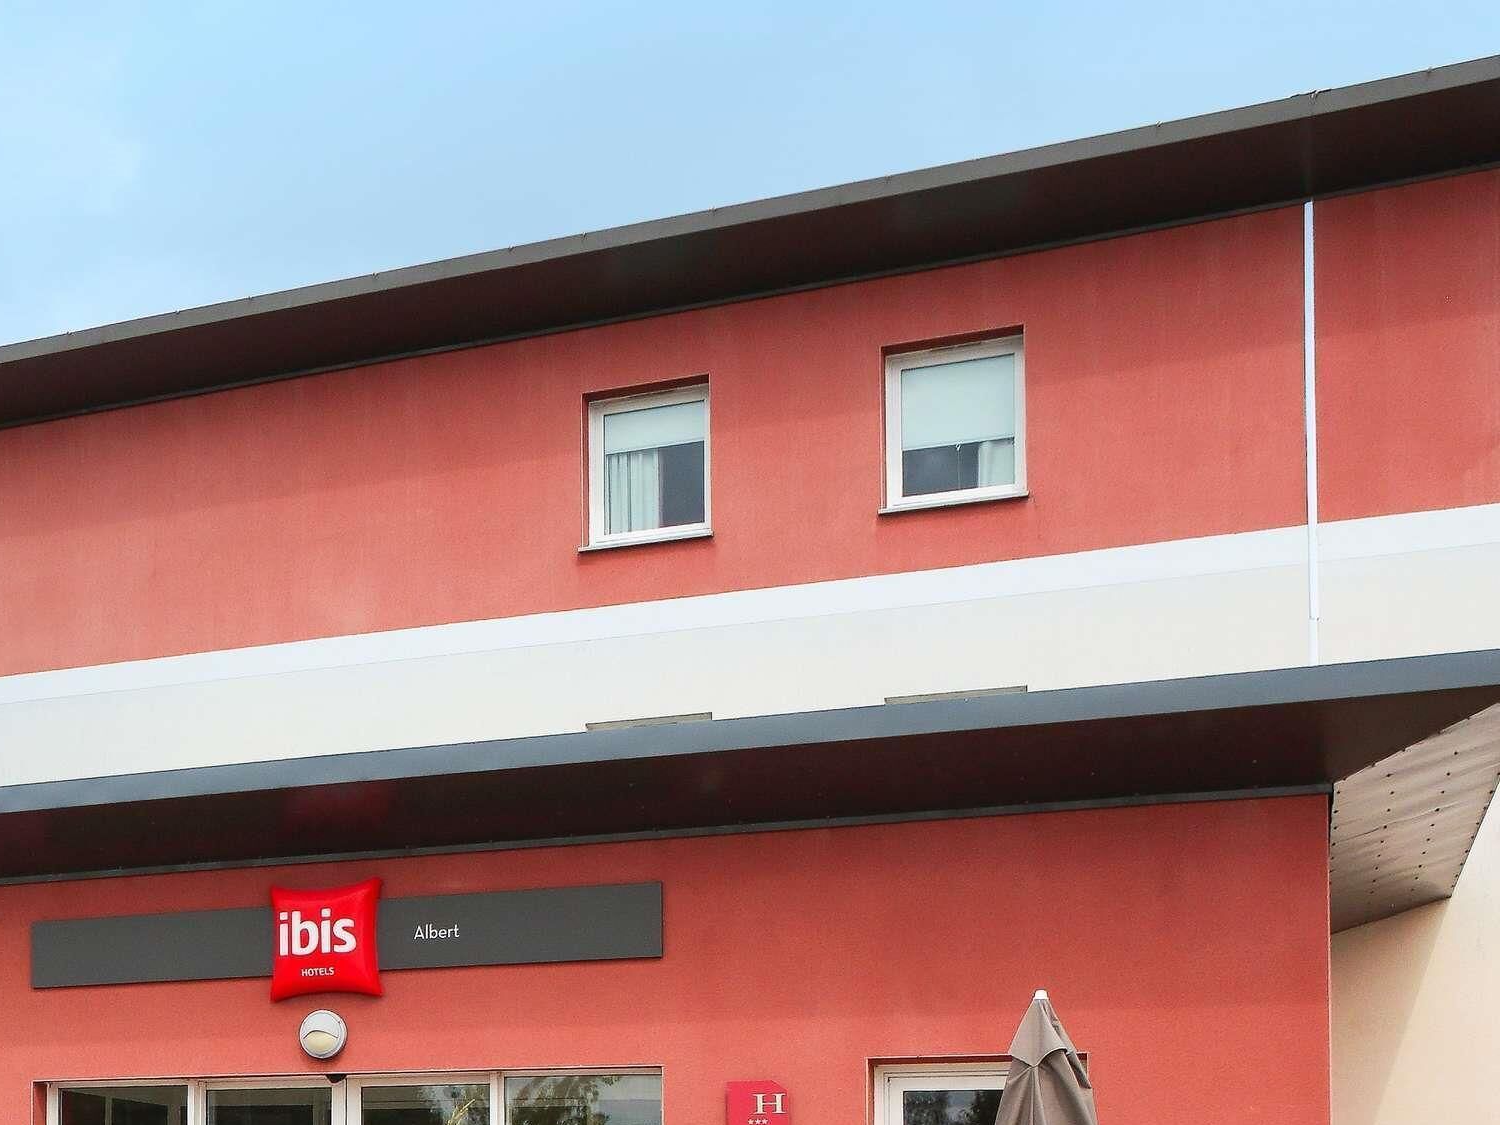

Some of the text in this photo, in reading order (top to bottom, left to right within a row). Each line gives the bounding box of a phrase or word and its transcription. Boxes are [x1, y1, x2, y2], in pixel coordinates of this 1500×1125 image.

[279, 908, 357, 957] ibis
[413, 923, 460, 940] Albert
[301, 967, 335, 977] HOTELS
[752, 1093, 786, 1114] H
